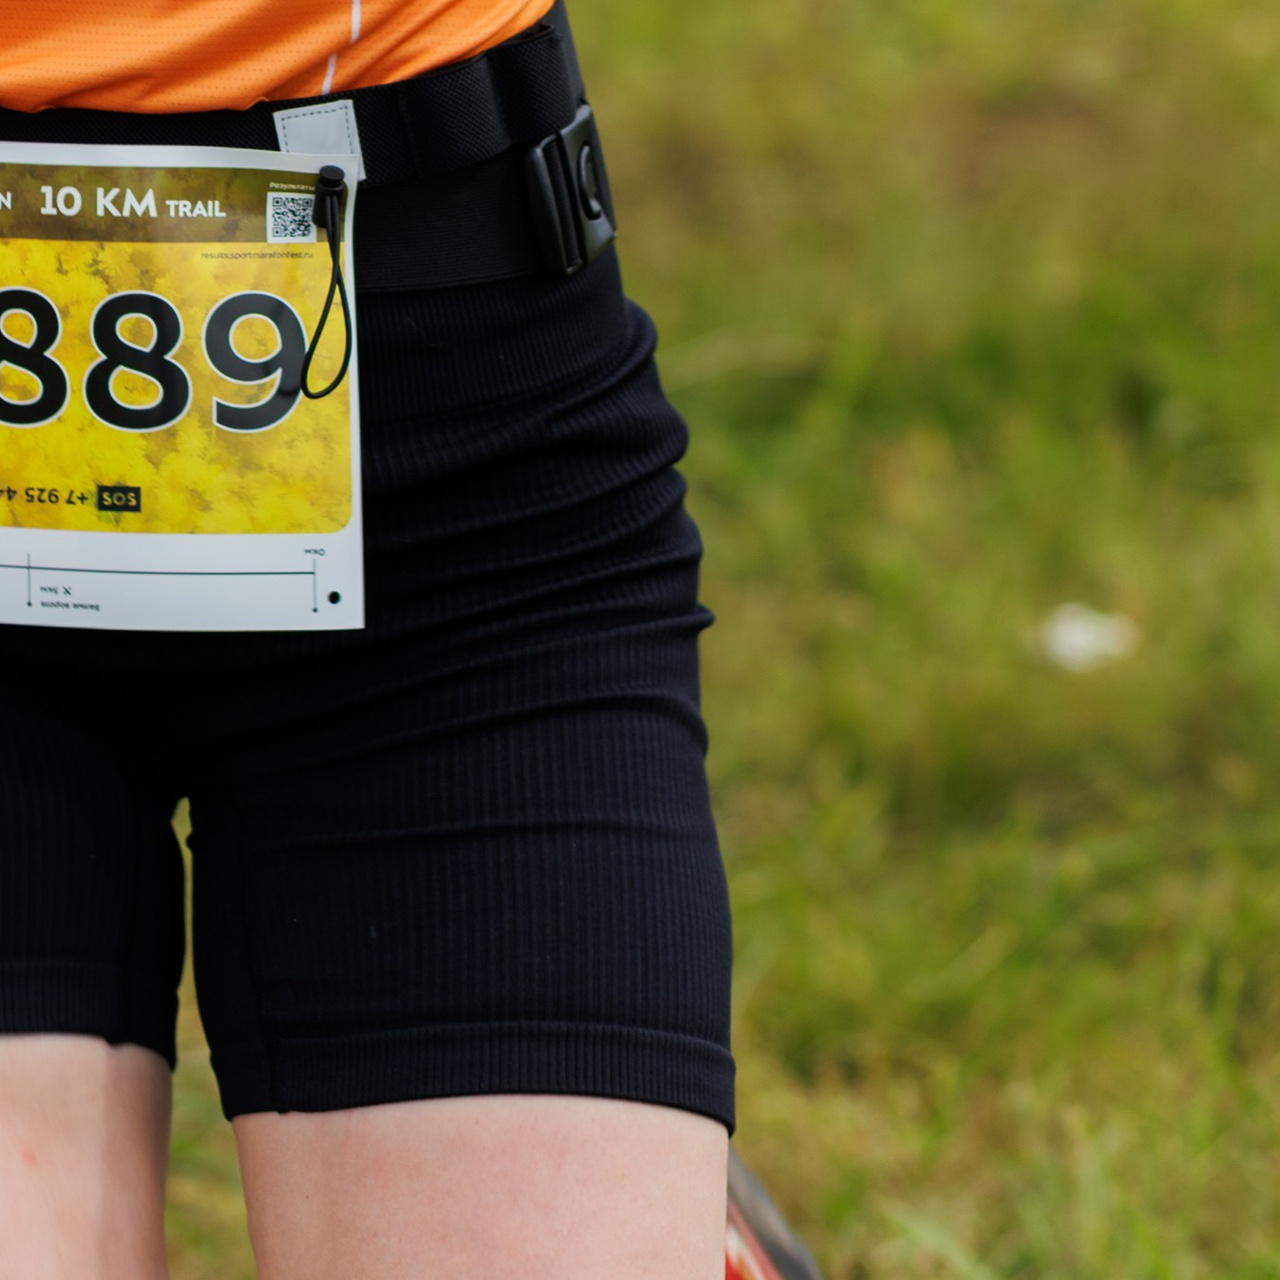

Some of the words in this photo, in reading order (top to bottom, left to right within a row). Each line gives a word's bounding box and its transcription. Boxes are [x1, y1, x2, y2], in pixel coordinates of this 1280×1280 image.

[40, 185, 82, 216] 10
[96, 187, 158, 217] KM
[165, 200, 226, 217] TRAIL
[24, 487, 59, 504] 925
[65, 489, 88, 505] +7
[102, 491, 137, 506] SOS
